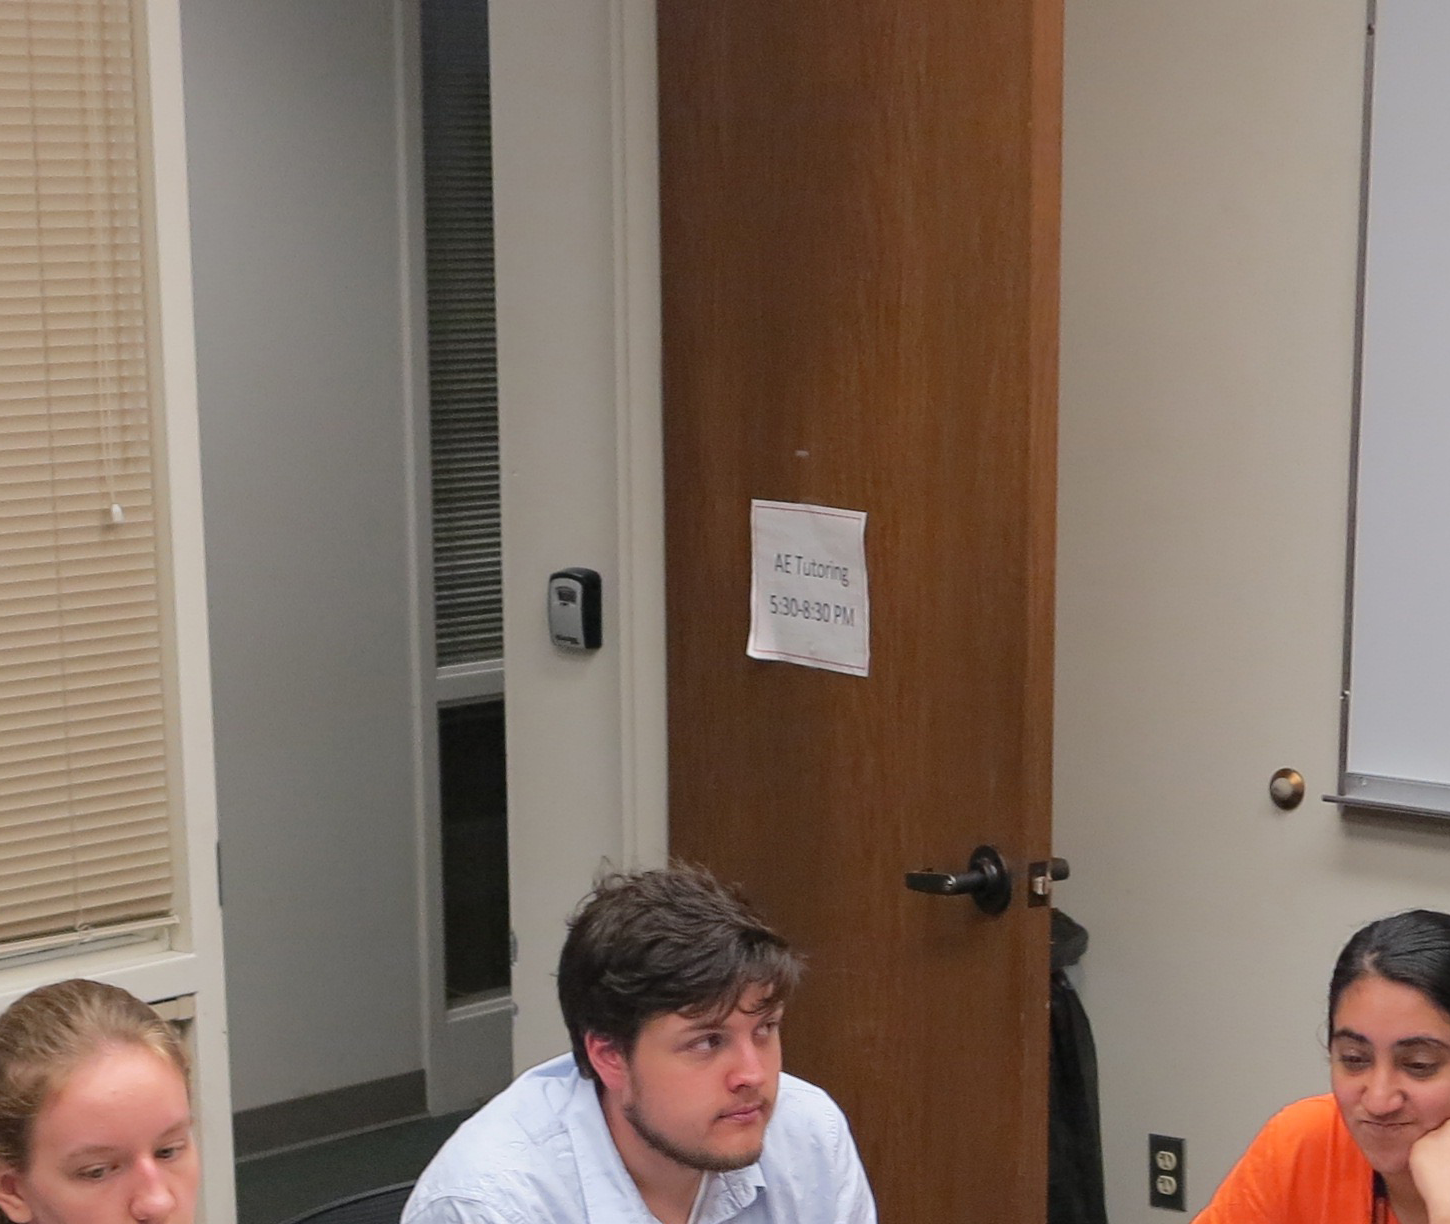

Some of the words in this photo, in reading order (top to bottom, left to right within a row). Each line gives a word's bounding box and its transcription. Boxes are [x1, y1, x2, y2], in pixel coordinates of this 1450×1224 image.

[774, 553, 791, 575] AE
[795, 555, 850, 588] Tutoring
[833, 604, 855, 627] PM
